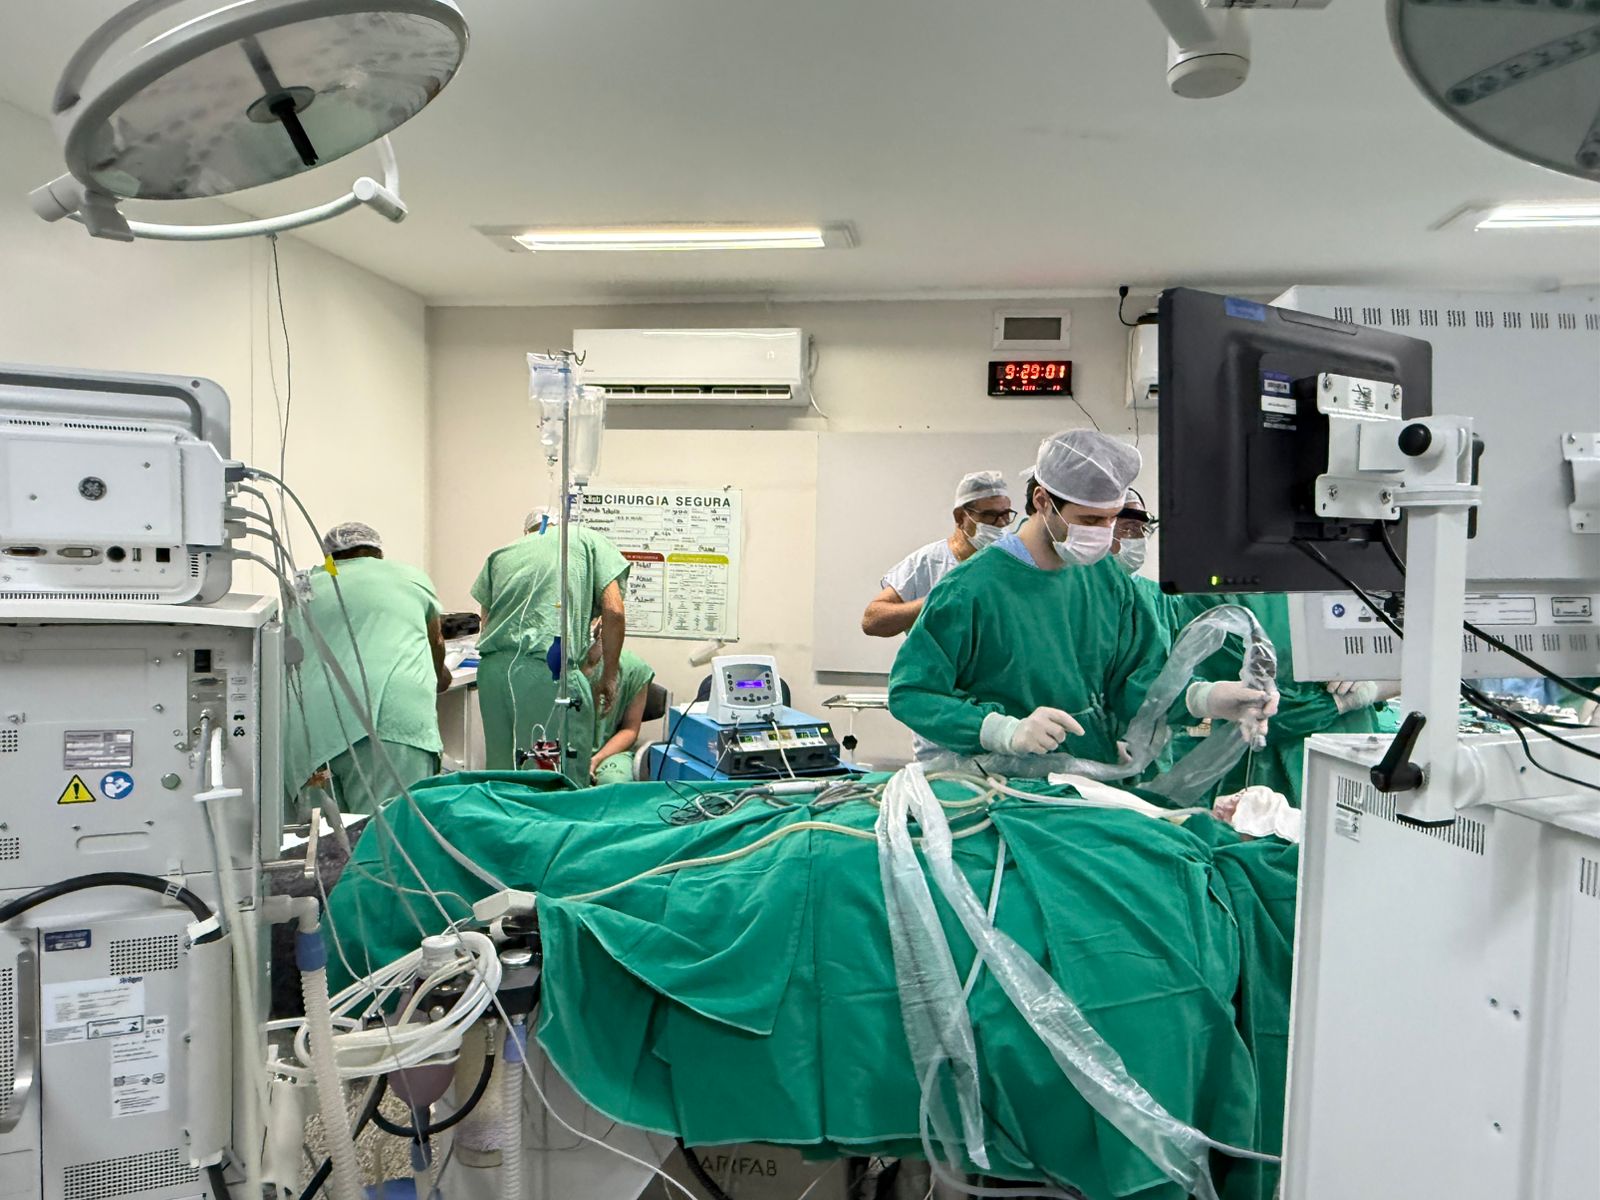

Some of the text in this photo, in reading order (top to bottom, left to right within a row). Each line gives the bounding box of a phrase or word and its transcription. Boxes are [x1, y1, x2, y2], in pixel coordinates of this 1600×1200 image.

[1005, 364, 1066, 379] 9:29:01
[604, 495, 669, 506] CIRURGIA
[676, 496, 731, 507] SEGURA
